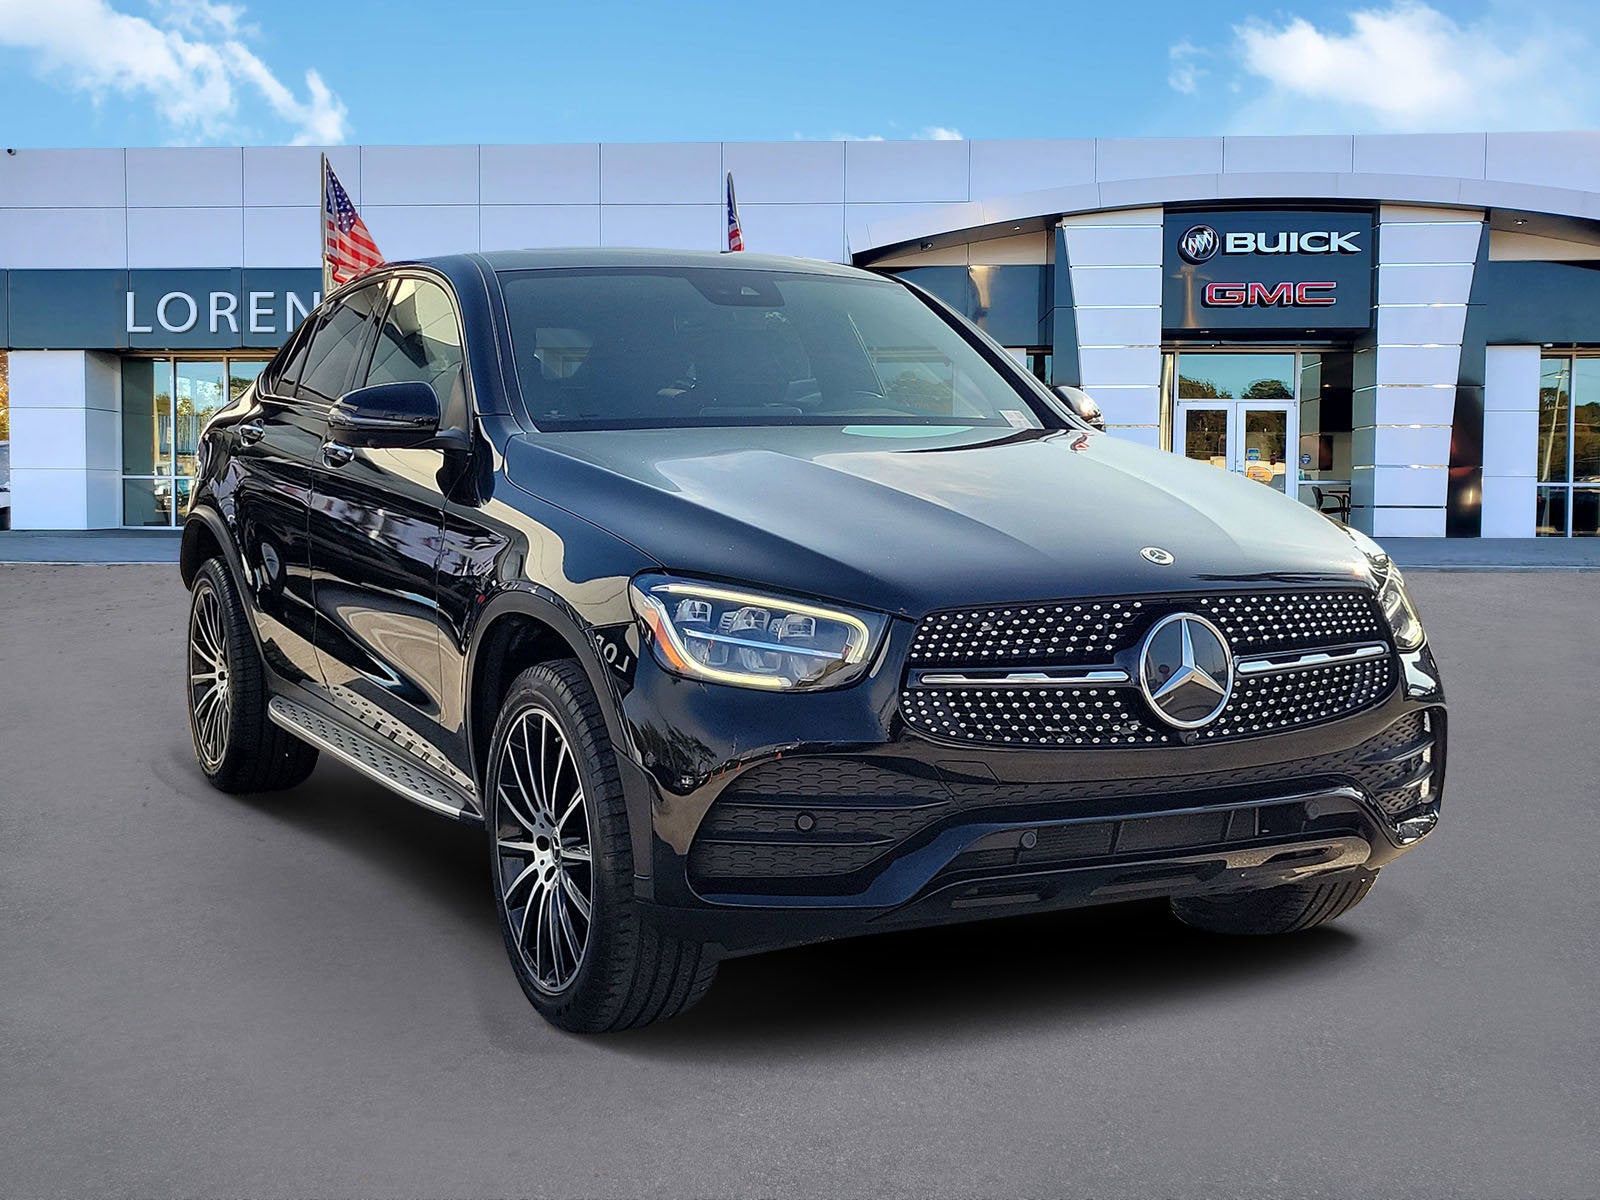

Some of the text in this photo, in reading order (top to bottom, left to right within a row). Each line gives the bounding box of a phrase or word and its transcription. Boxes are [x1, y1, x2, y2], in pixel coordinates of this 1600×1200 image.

[1224, 231, 1362, 253] BUICK
[1205, 281, 1337, 306] GMC
[126, 291, 321, 334] LOREN
